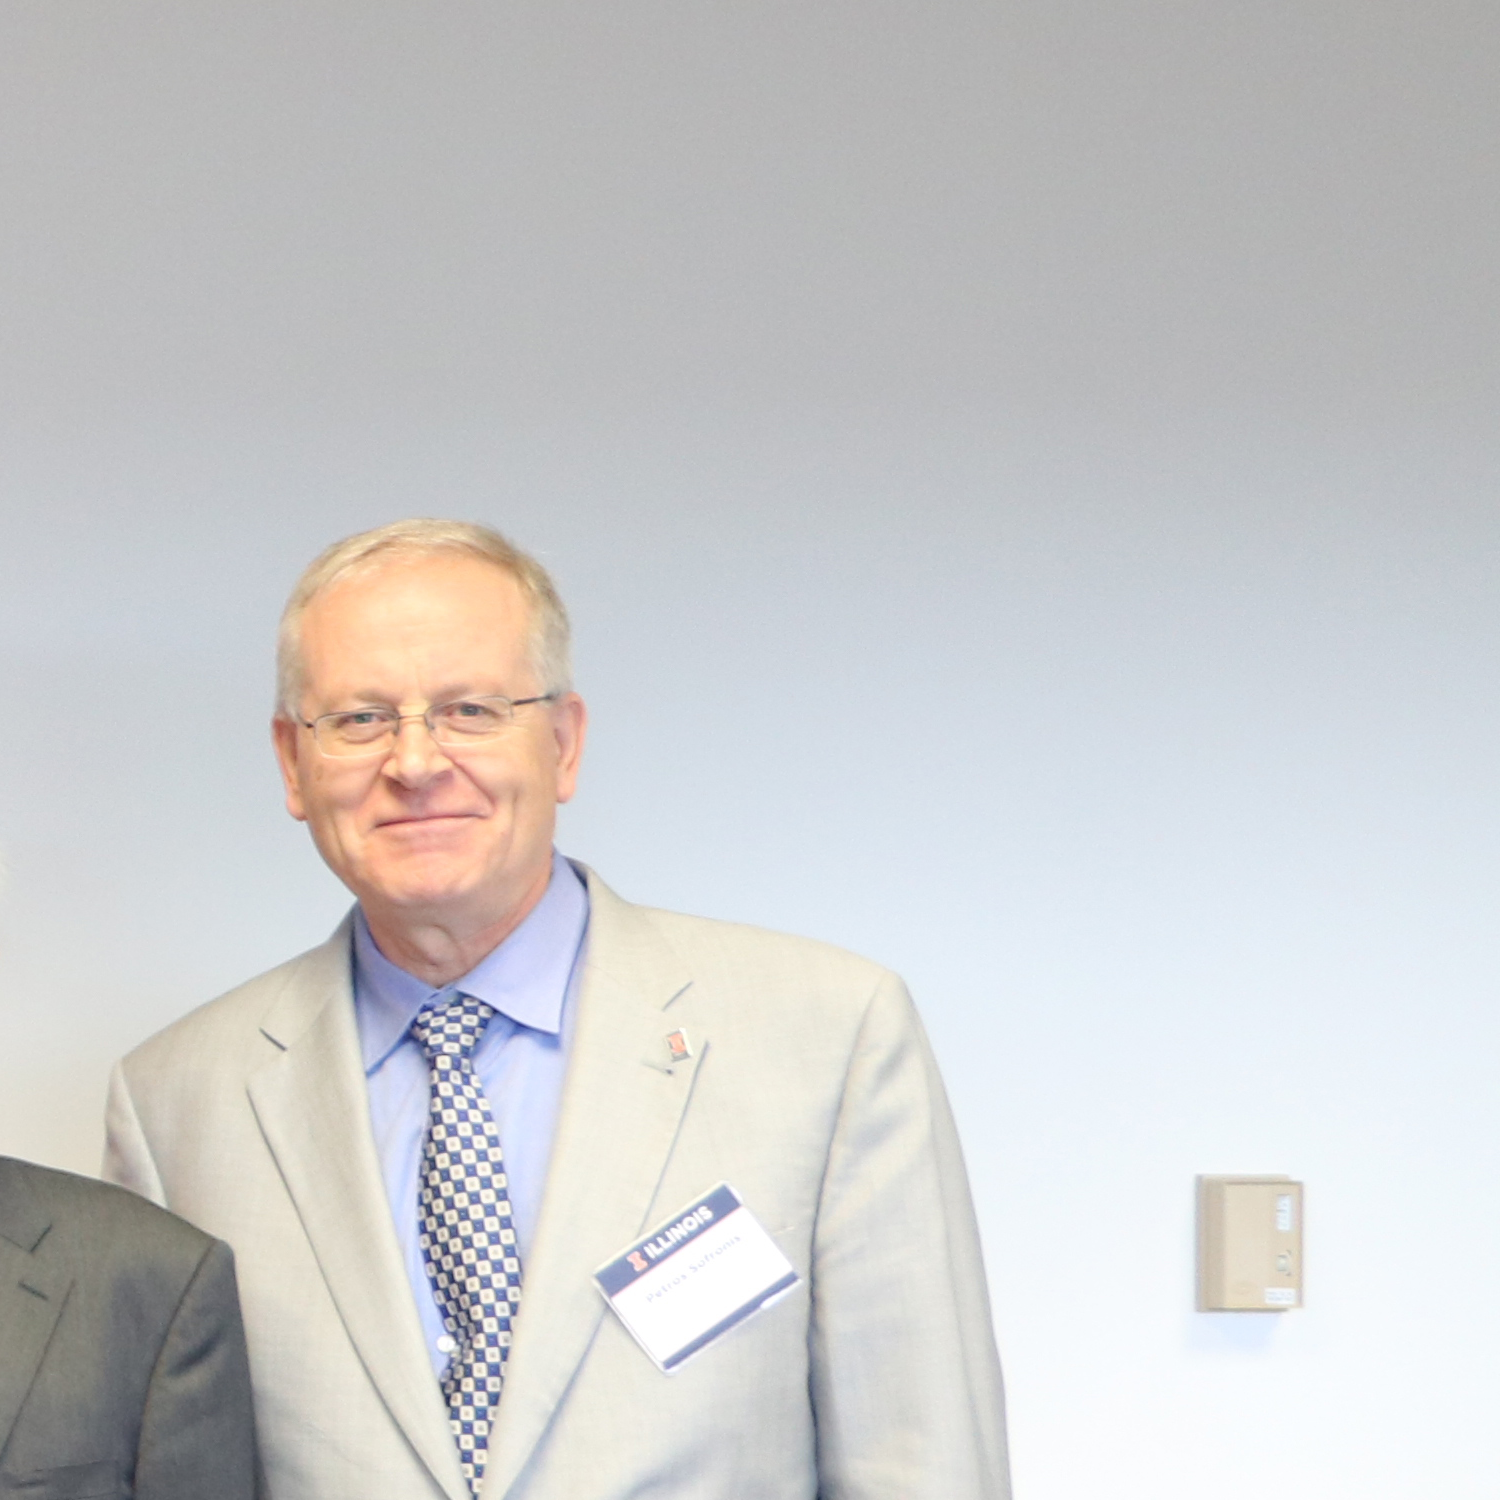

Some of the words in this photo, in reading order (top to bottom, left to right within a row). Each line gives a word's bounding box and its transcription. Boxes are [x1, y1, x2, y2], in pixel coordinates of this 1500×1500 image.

[643, 1205, 714, 1260] ILLINOIS
[646, 1273, 688, 1303] Petros
[688, 1235, 742, 1273] Sofronis
